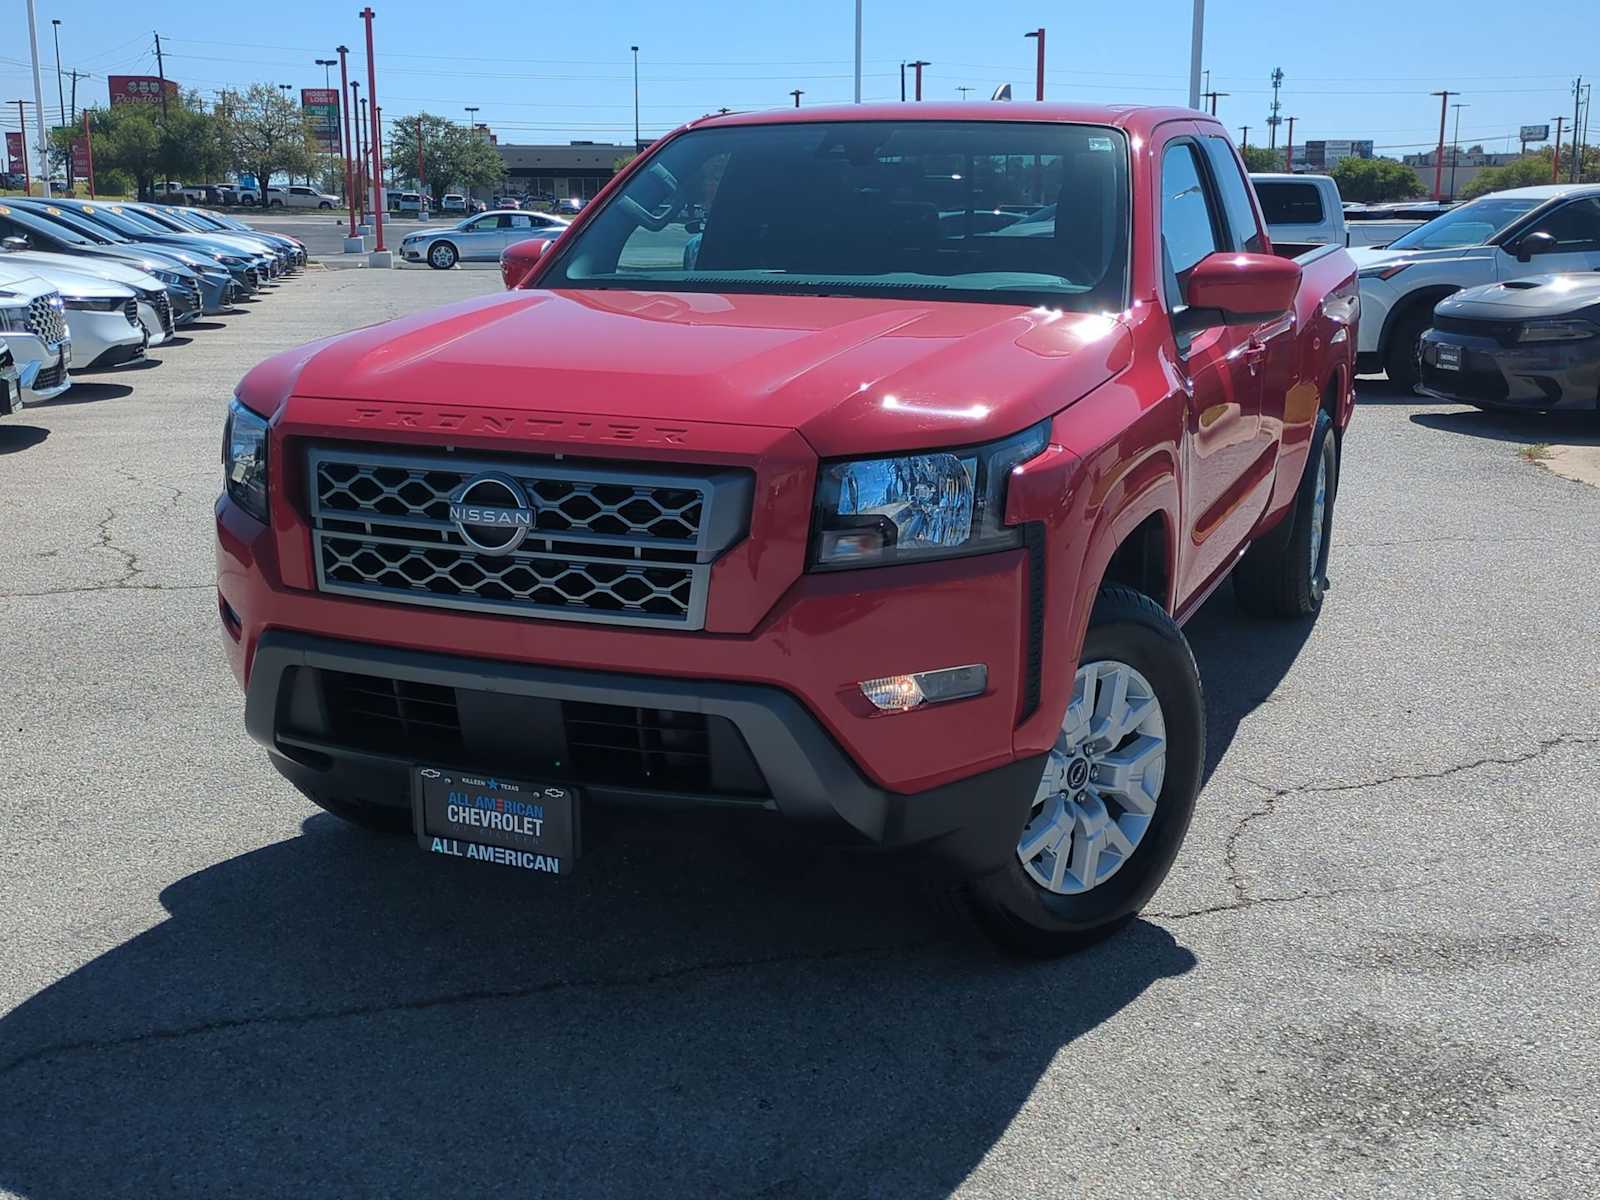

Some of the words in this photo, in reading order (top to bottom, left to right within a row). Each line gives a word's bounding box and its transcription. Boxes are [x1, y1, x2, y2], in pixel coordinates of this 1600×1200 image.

[348, 407, 688, 444] FRONTIER
[449, 506, 531, 524] NISSAN
[461, 777, 486, 787] KILLEEN
[500, 783, 520, 792] TEXAS
[447, 791, 471, 808] ALL
[475, 796, 544, 818] AMERICAN
[447, 804, 544, 837] CHEVROLET
[431, 837, 463, 857] ALL
[466, 843, 560, 874] AMERICAN
